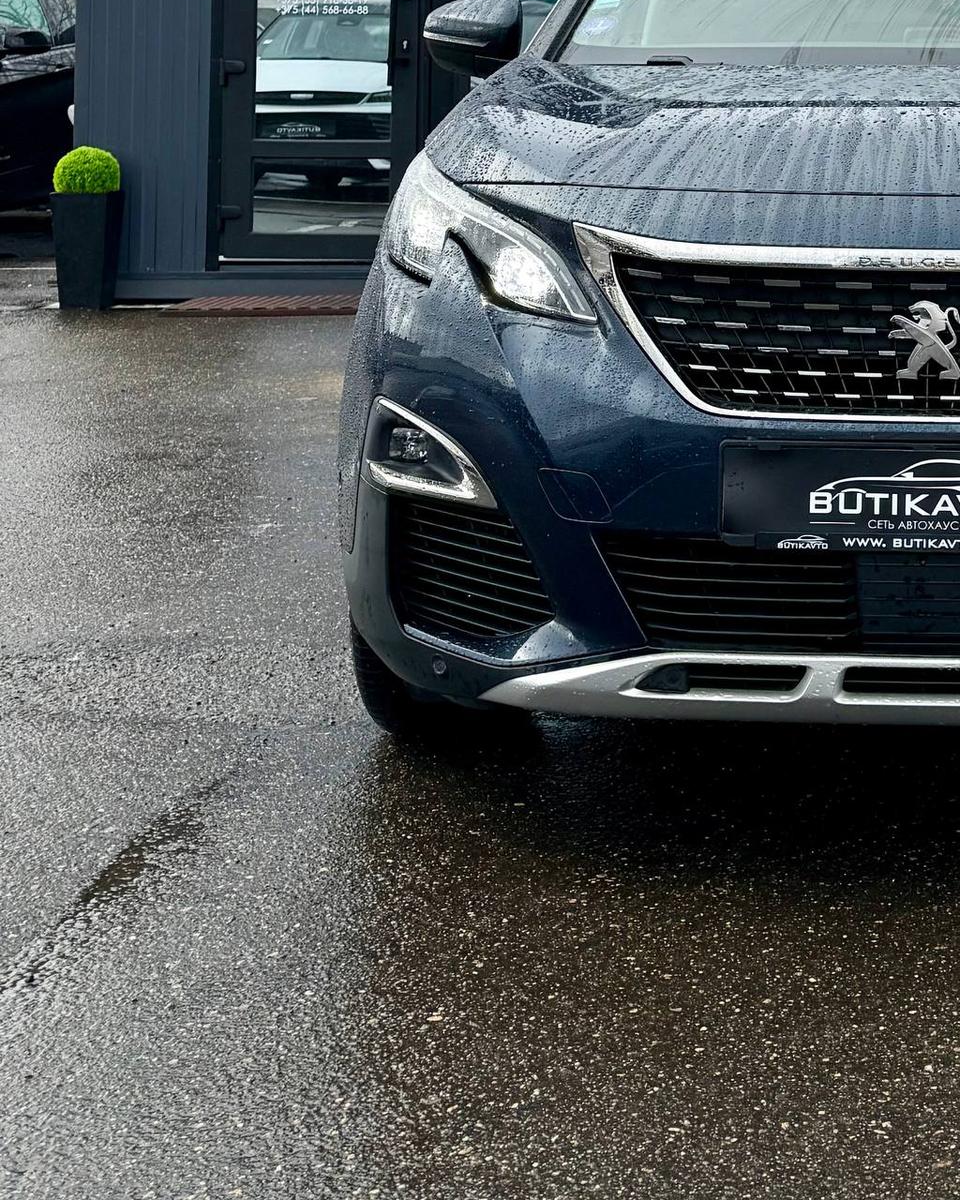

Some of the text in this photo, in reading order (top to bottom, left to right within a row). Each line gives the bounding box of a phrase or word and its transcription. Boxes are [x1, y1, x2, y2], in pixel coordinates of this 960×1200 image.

[301, 5, 320, 16] (44)
[322, 5, 369, 15] 568-66-88
[867, 519, 895, 530] СЕТЬ
[777, 541, 829, 550] BUTIKAVTO
